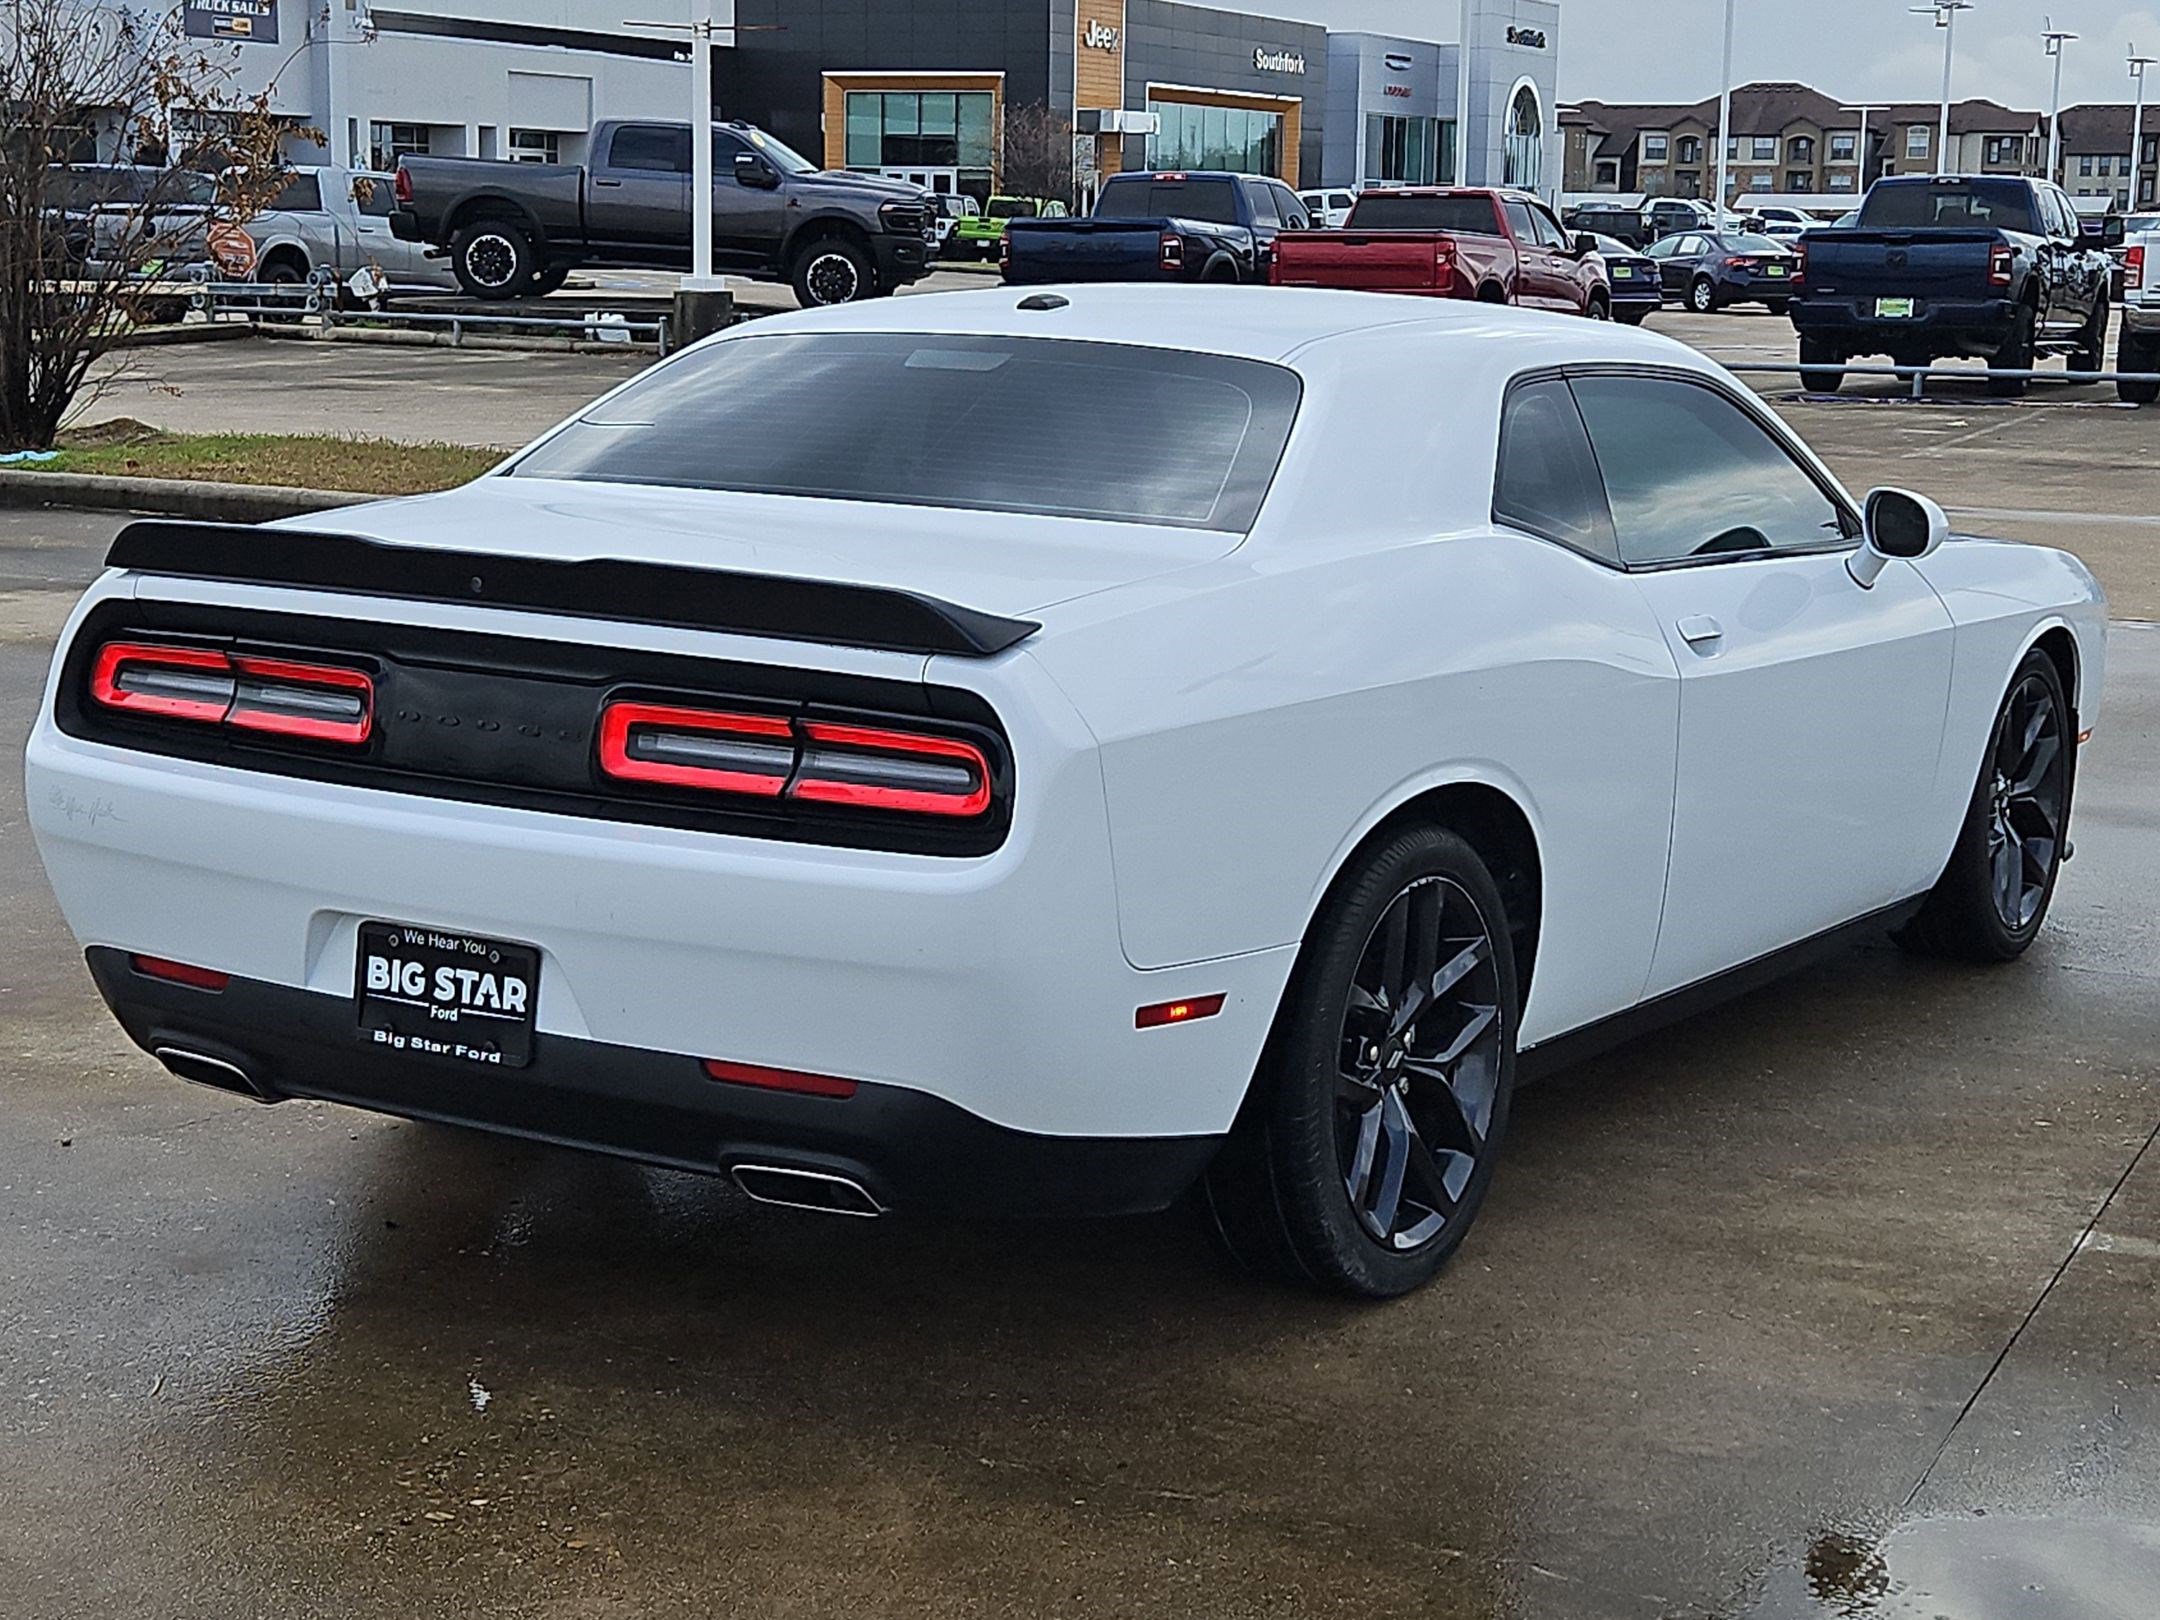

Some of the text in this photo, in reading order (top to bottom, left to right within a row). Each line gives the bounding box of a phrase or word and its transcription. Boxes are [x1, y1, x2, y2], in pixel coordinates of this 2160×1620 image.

[1255, 48, 1305, 75] Southfork
[404, 929, 487, 956] We Hear You
[367, 955, 527, 1013] BIG STAR
[430, 1005, 459, 1022] Ford
[373, 1030, 502, 1064] Big Star Ford
